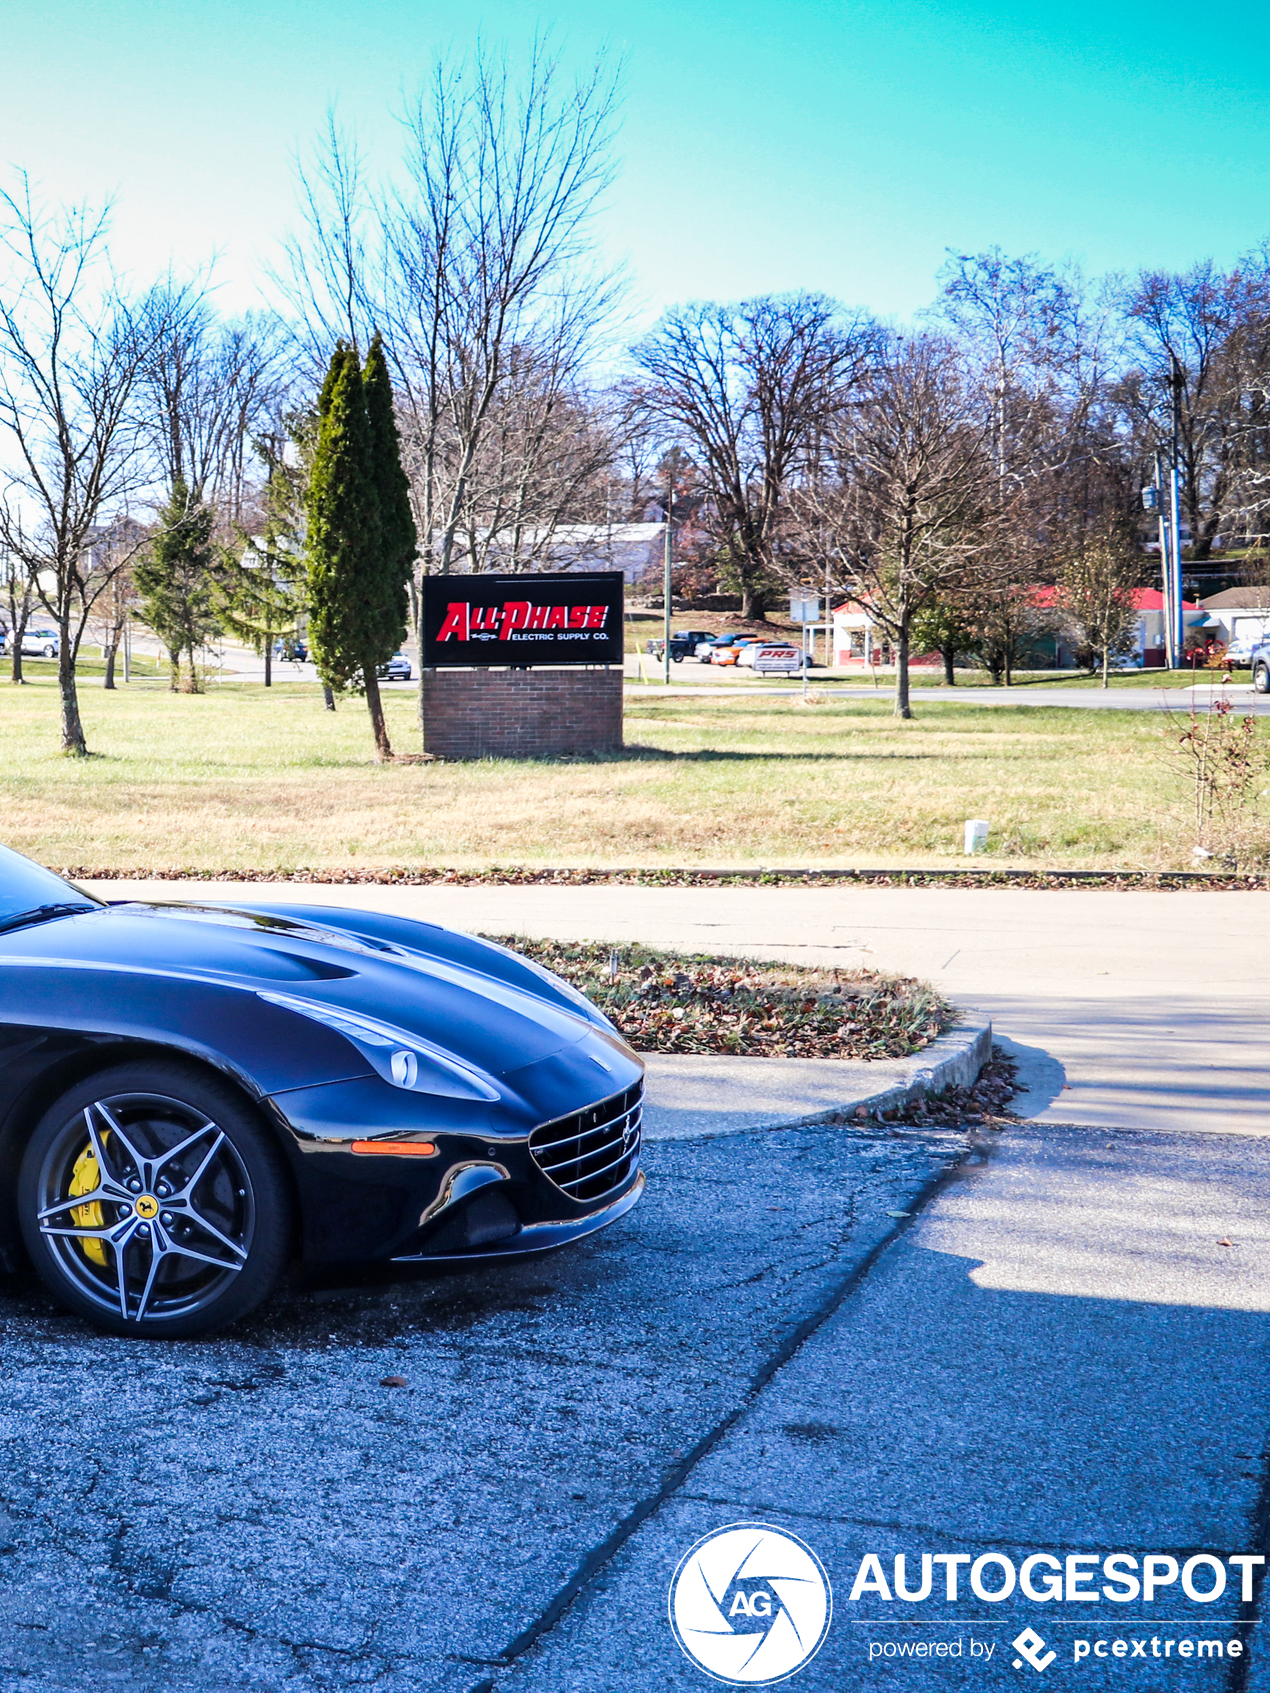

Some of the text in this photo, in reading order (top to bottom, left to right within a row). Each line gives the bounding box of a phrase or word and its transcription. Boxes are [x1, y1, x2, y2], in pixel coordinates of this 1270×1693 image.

[512, 632, 609, 641] ELECTRIC SUPPLY CO.
[758, 650, 798, 658] PRS
